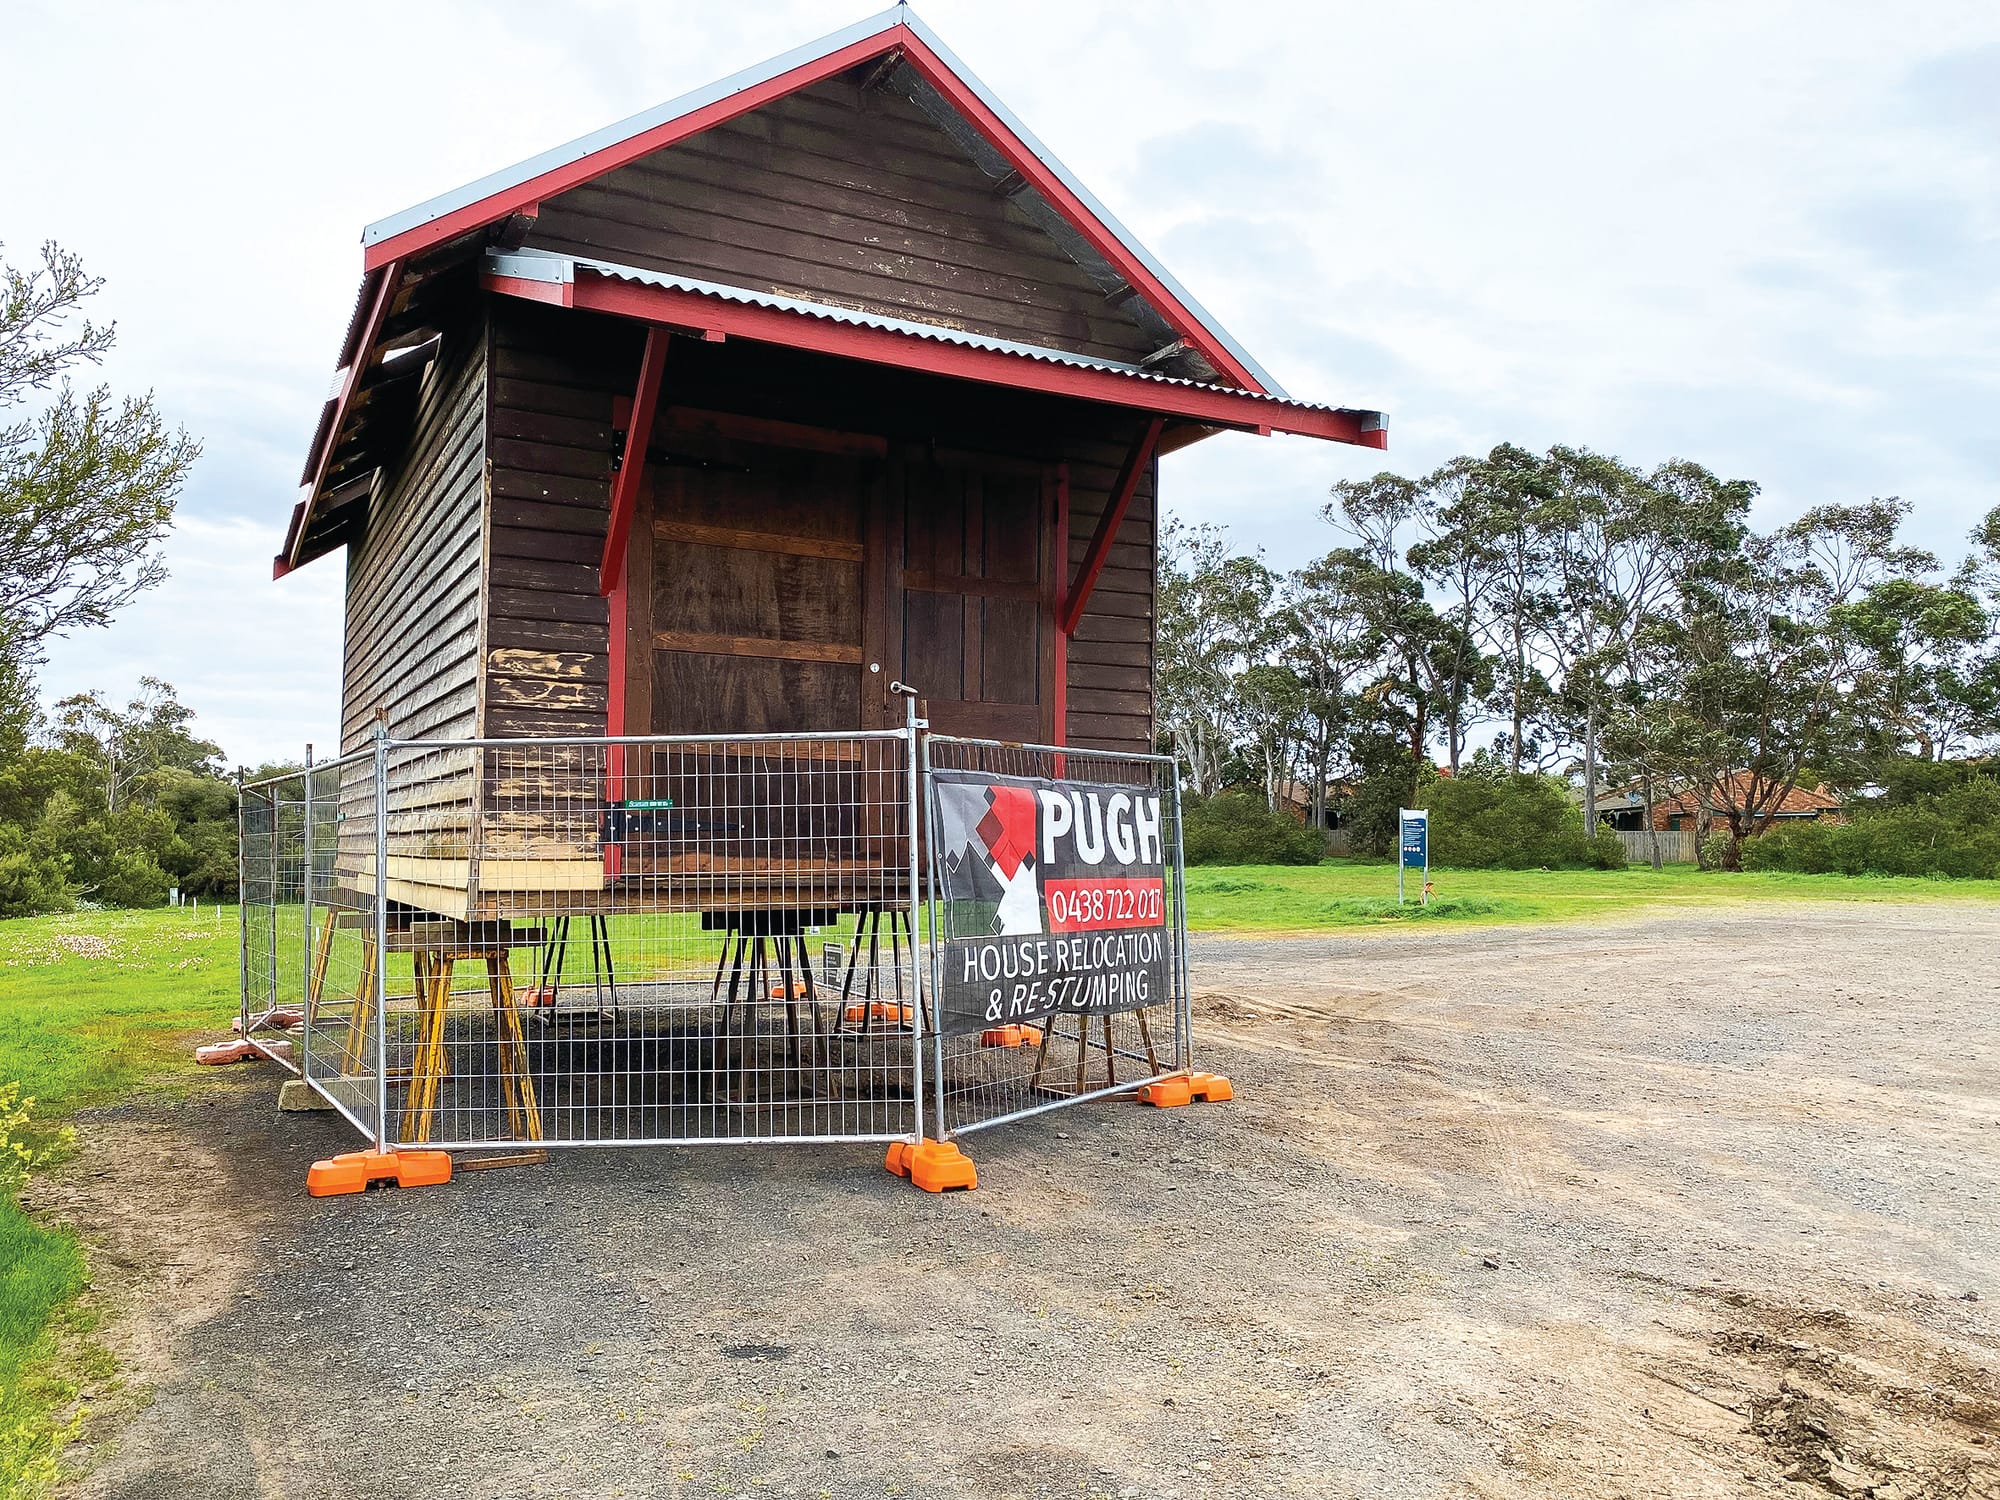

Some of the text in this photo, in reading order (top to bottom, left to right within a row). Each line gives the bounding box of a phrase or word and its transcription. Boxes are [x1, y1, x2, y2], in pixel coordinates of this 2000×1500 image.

[1037, 790, 1162, 865] PUGH
[1053, 888, 1160, 923] 0438 722 017
[963, 933, 1163, 983] HOUSE RELOCATION
[985, 970, 1148, 1021] & RE-STUMPING
